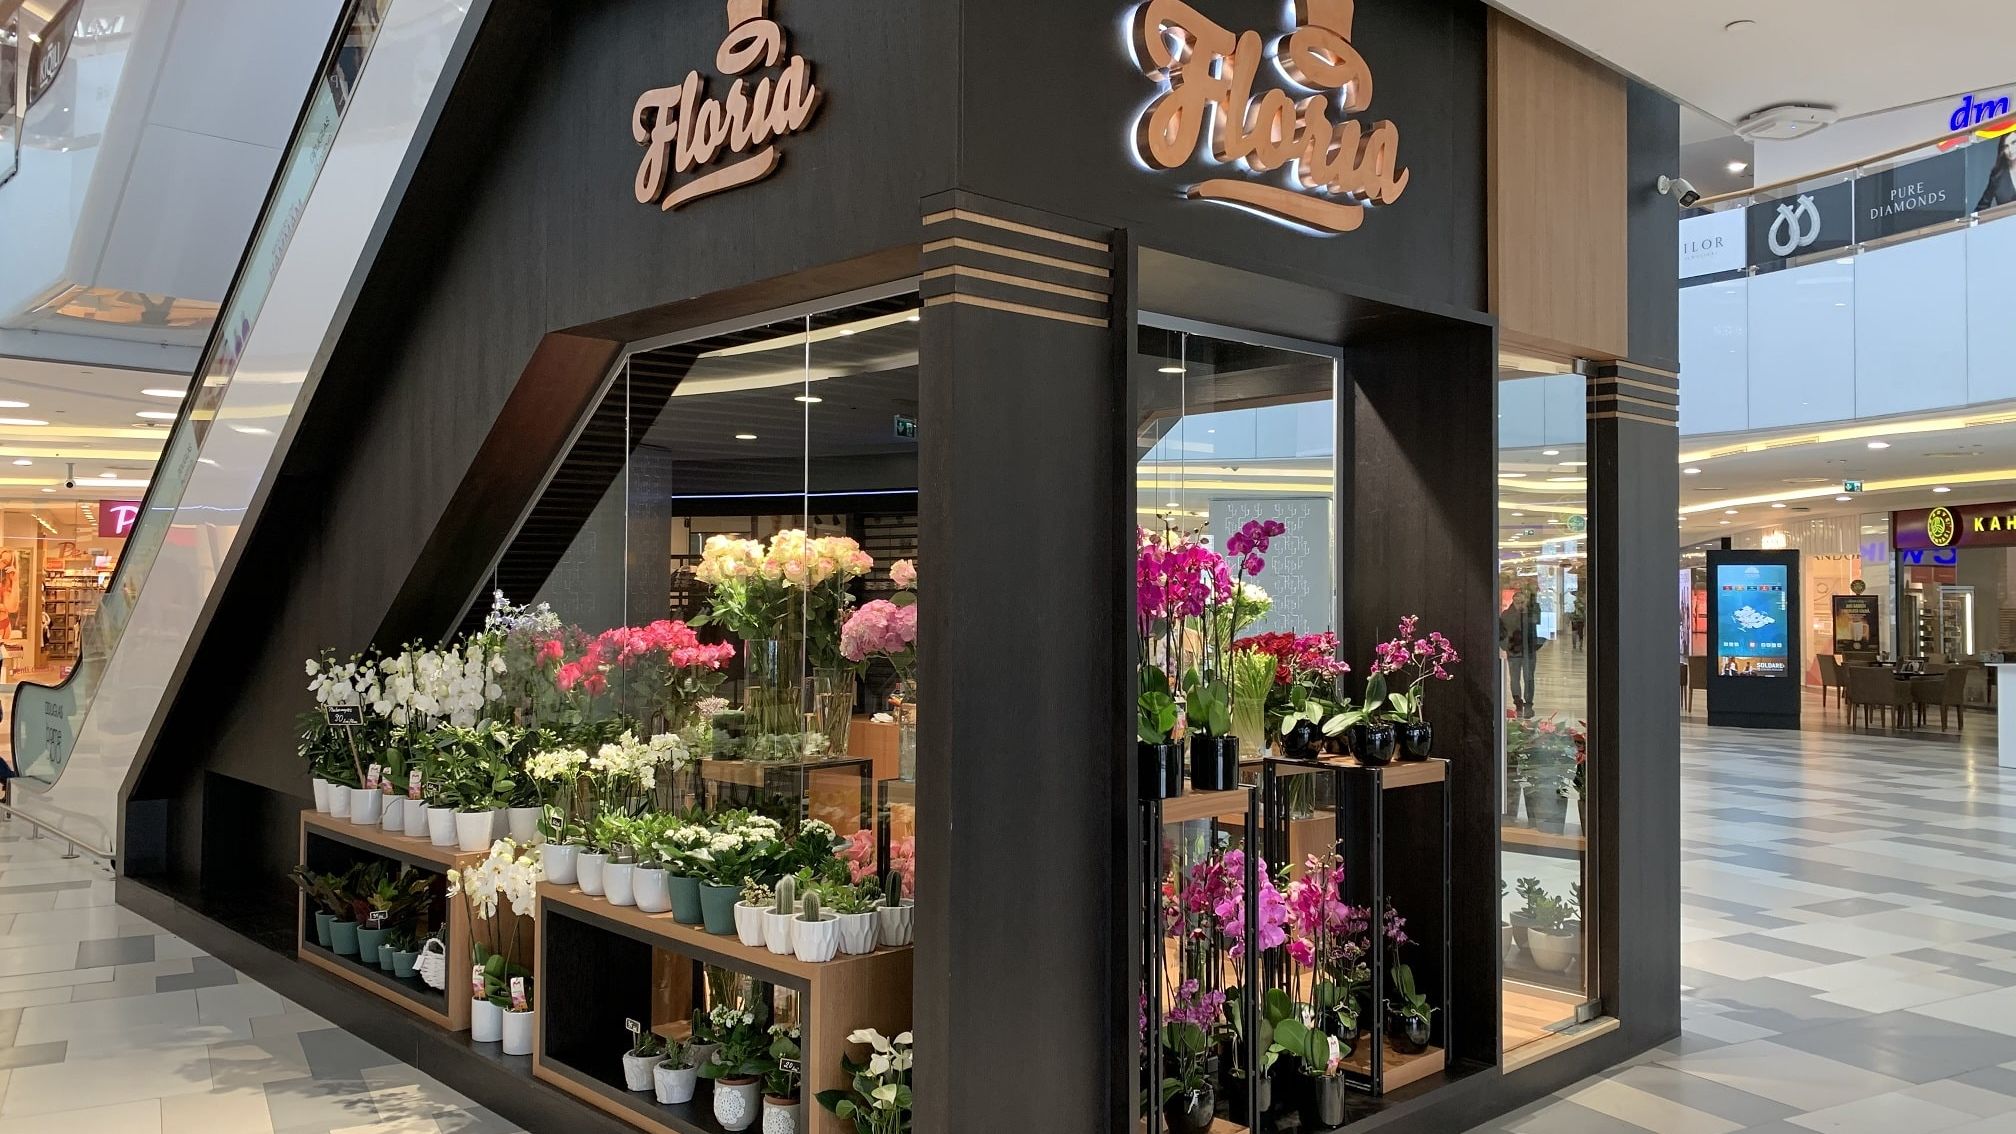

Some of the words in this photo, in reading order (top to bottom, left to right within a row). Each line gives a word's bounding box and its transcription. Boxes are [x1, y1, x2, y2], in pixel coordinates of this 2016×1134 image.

[1134, 0, 1410, 205] Floria
[1949, 94, 2010, 131] dm
[632, 53, 818, 205] Floria
[1870, 189, 1946, 220] DIAMONDS
[1890, 181, 1924, 201] PURE
[1974, 515, 2016, 532] KAH
